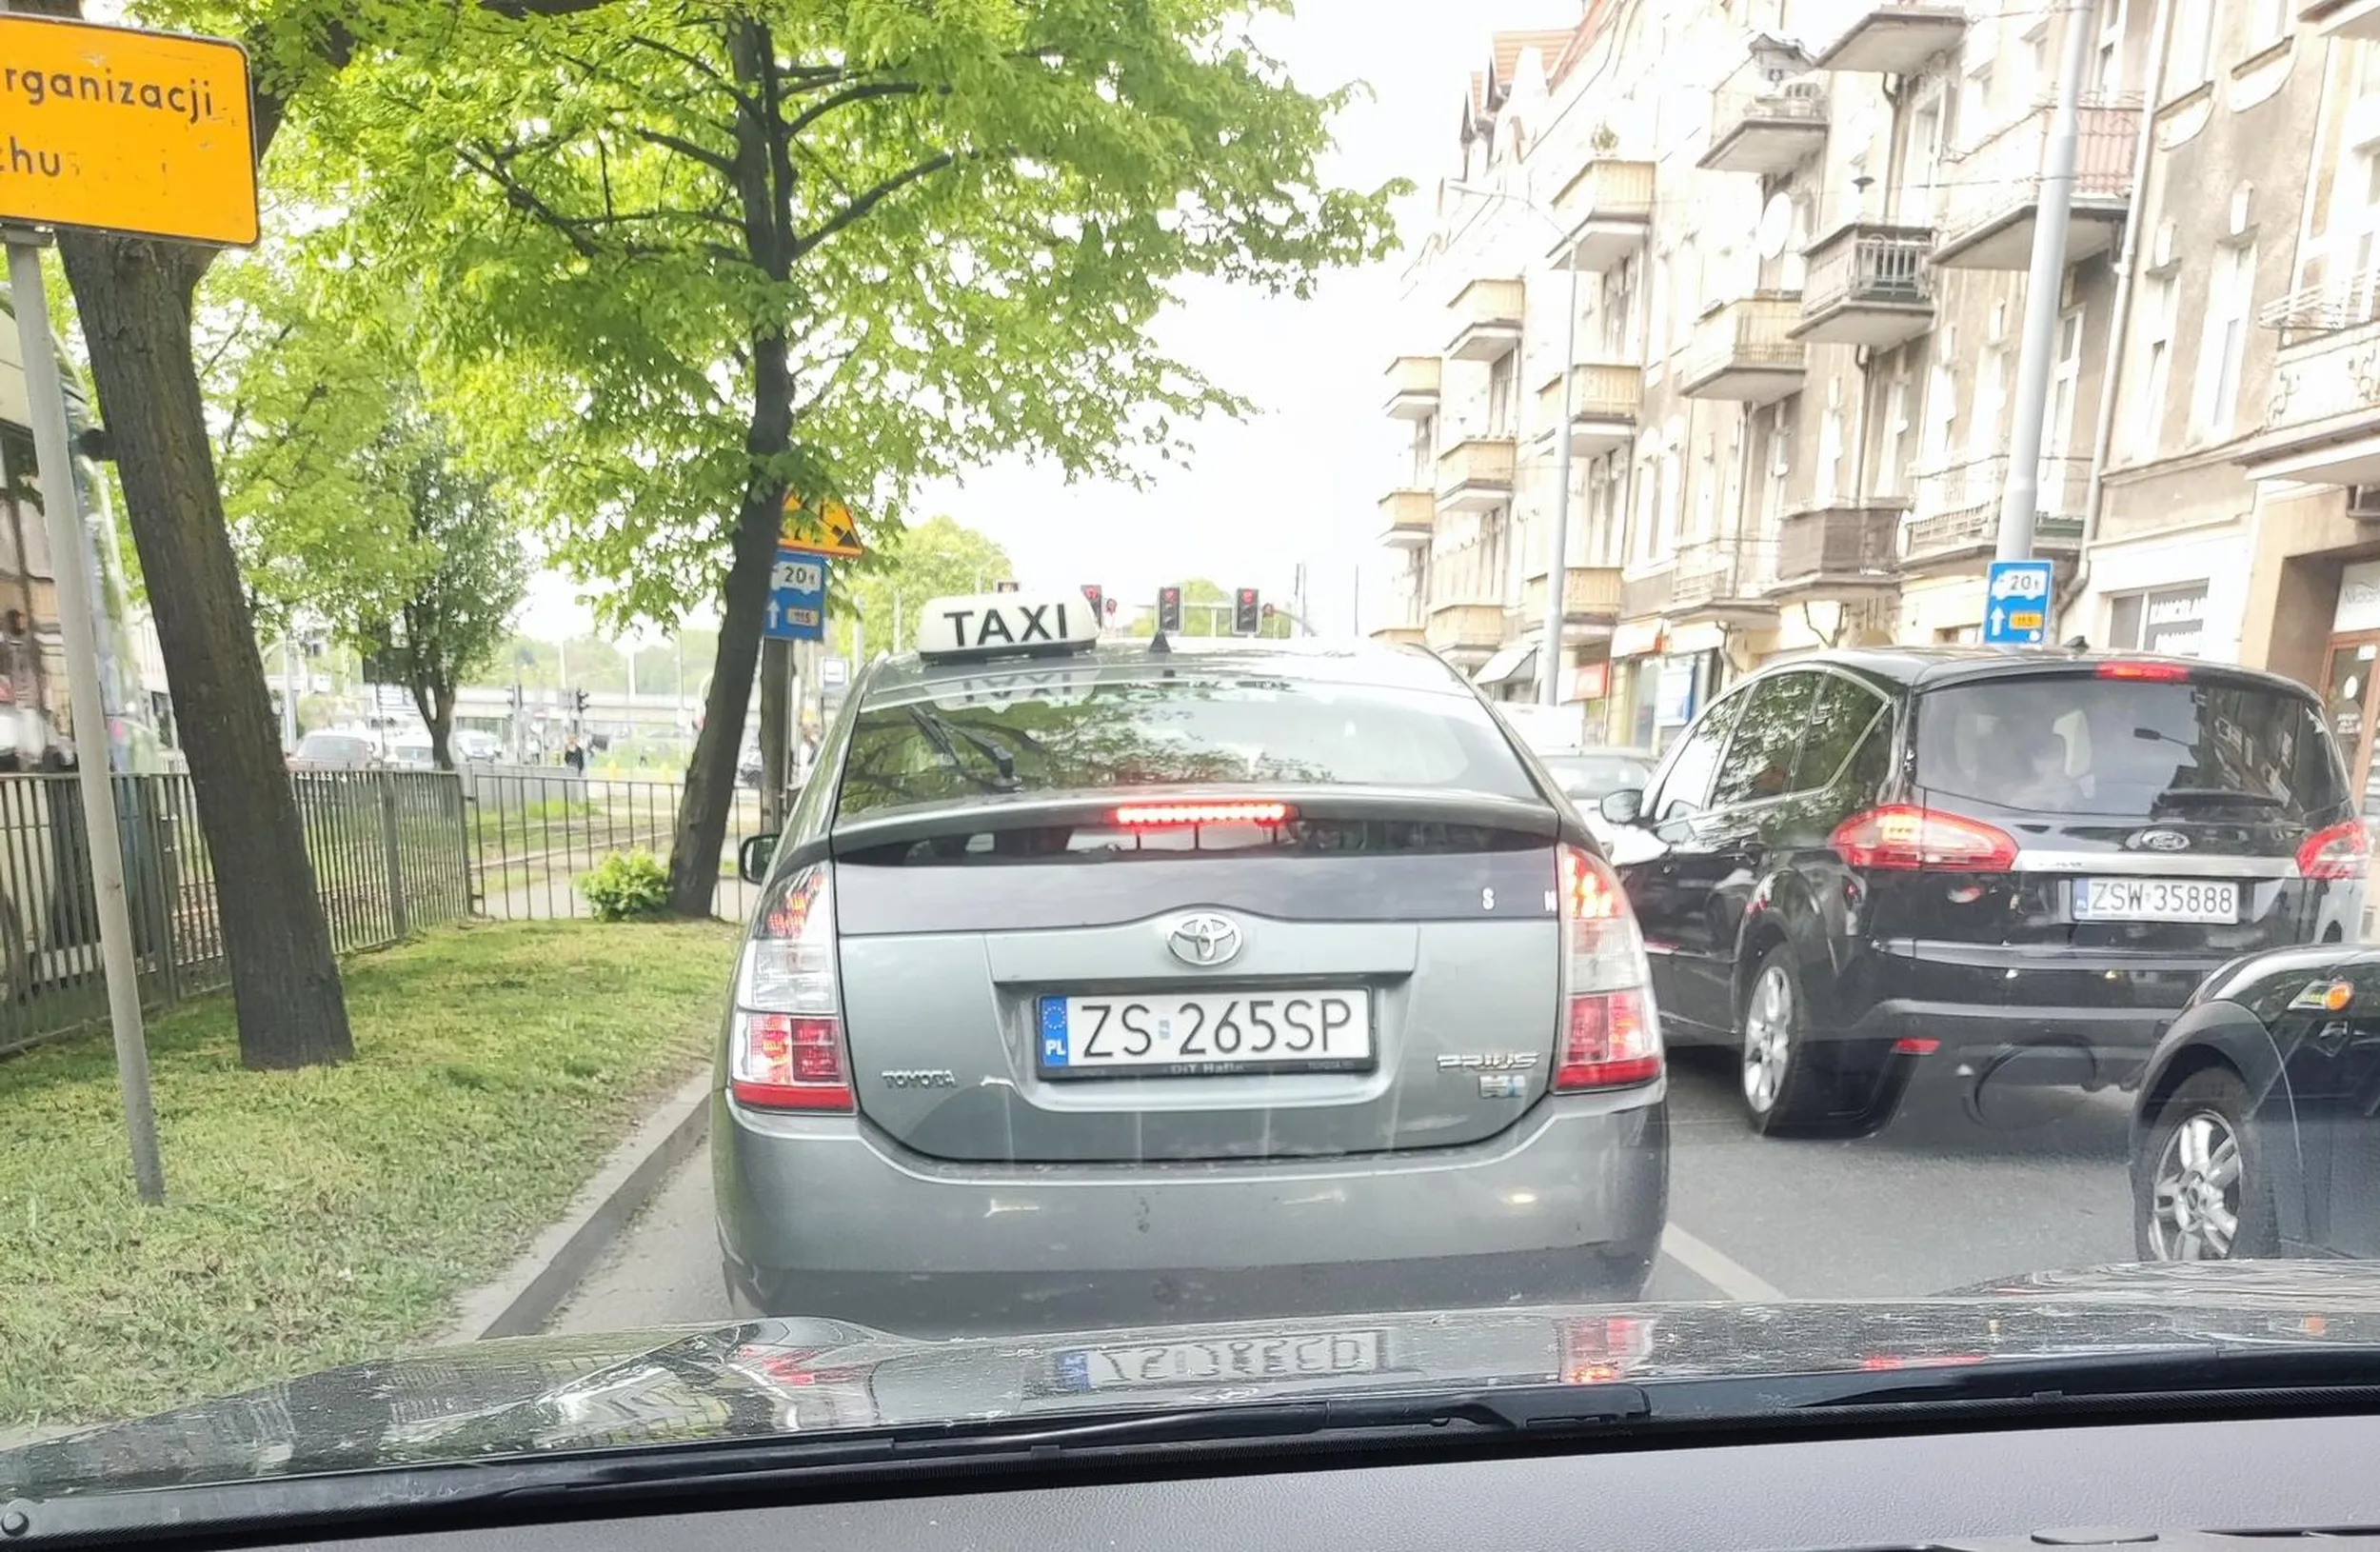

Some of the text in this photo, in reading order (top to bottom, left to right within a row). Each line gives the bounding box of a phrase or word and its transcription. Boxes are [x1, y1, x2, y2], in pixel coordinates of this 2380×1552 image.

[0, 136, 61, 177] hu
[943, 604, 1067, 647] TAXI
[2092, 883, 2143, 911] ZSW
[2153, 885, 2232, 914] 35888
[1081, 999, 1352, 1059] ZS 265SP
[1045, 1039, 1066, 1056] PL
[882, 1069, 956, 1088] TOYOTA
